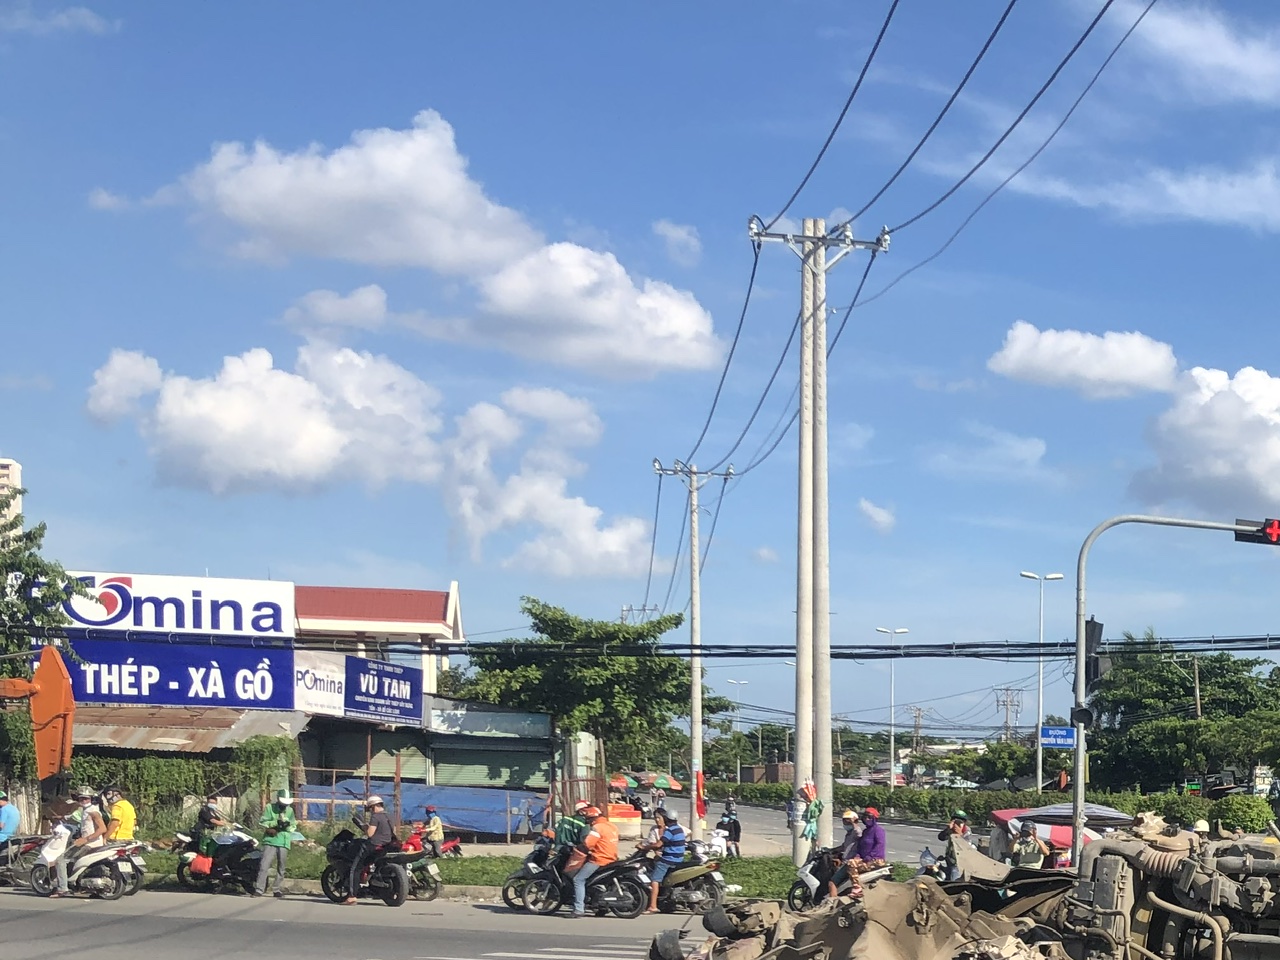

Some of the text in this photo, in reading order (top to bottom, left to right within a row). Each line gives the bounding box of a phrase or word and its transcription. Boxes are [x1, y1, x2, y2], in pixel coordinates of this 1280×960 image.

[80, 657, 160, 697] THÉP
[188, 661, 225, 699] XÀ
[235, 658, 274, 701] GỒ
[360, 671, 378, 695] VŨ
